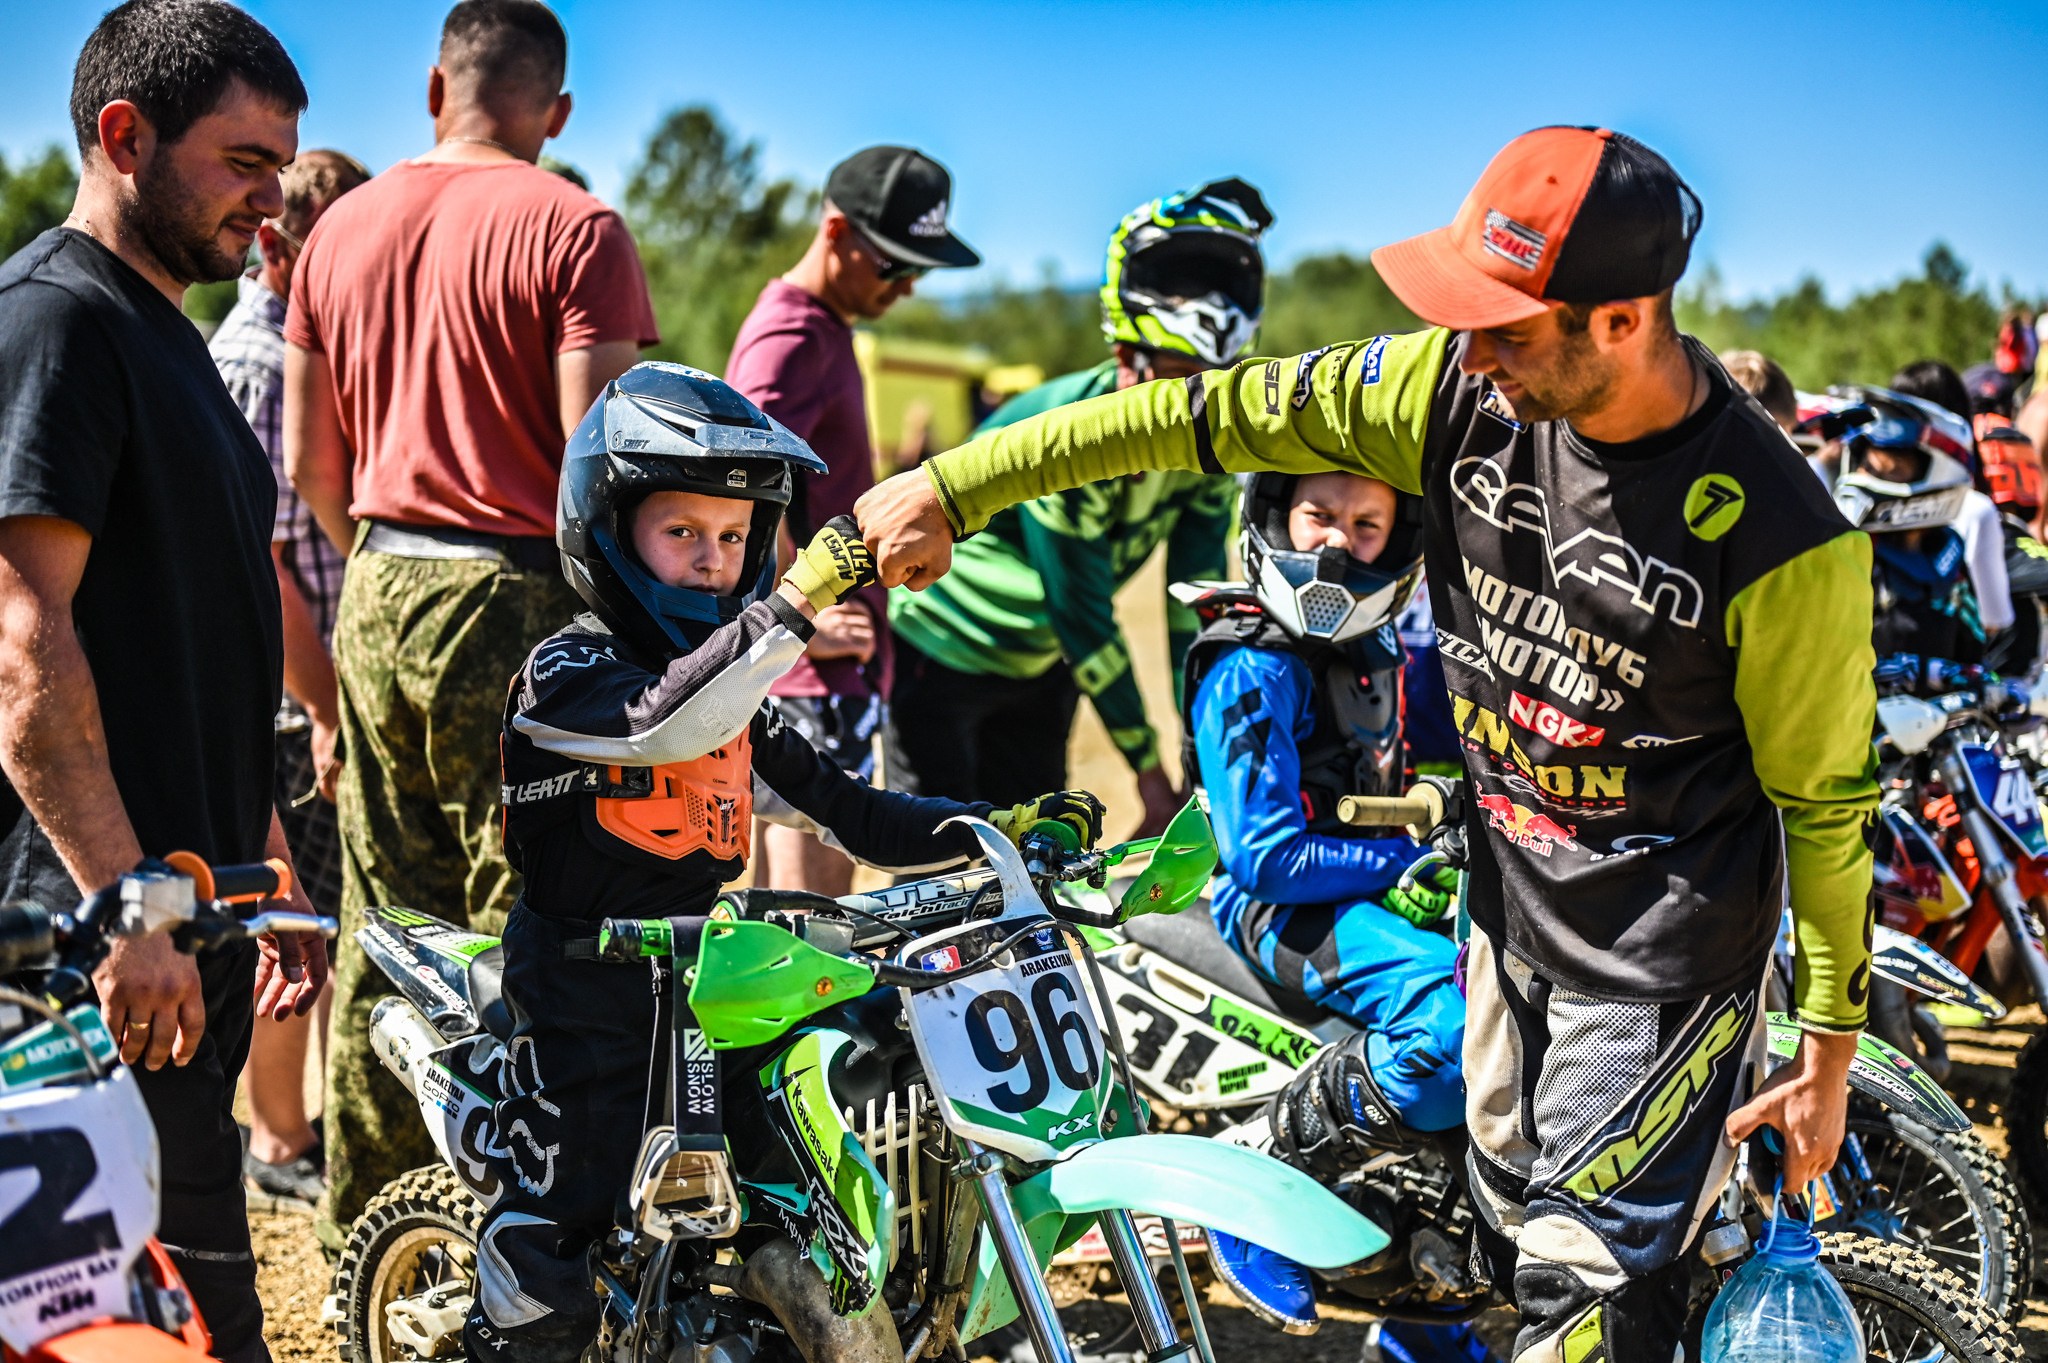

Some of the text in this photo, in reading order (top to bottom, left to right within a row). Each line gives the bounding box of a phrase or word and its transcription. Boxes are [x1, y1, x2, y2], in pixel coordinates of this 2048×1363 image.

[621, 438, 651, 450] SHIFT
[1689, 480, 1745, 528] 7
[1475, 613, 1625, 712] МОТОР»
[1508, 692, 1587, 748] NGK
[1448, 689, 1627, 798] INSON
[516, 769, 581, 803] LEATT
[1517, 832, 1553, 858] Bull
[941, 898, 971, 911] racin
[1019, 953, 1073, 978] ARAKELYAN
[965, 972, 1099, 1114] 96
[1117, 993, 1220, 1095] 31
[423, 1080, 461, 1113] GoPro
[426, 1067, 466, 1104] ARAKELYAN
[687, 1062, 701, 1114] SNOW
[701, 1062, 715, 1114] SLOW
[1562, 1007, 1746, 1200] MSR
[792, 1082, 839, 1184] Kawasaki
[1048, 1111, 1095, 1141] KX
[38, 1289, 95, 1324] KTM
[470, 1315, 509, 1352] FOX
